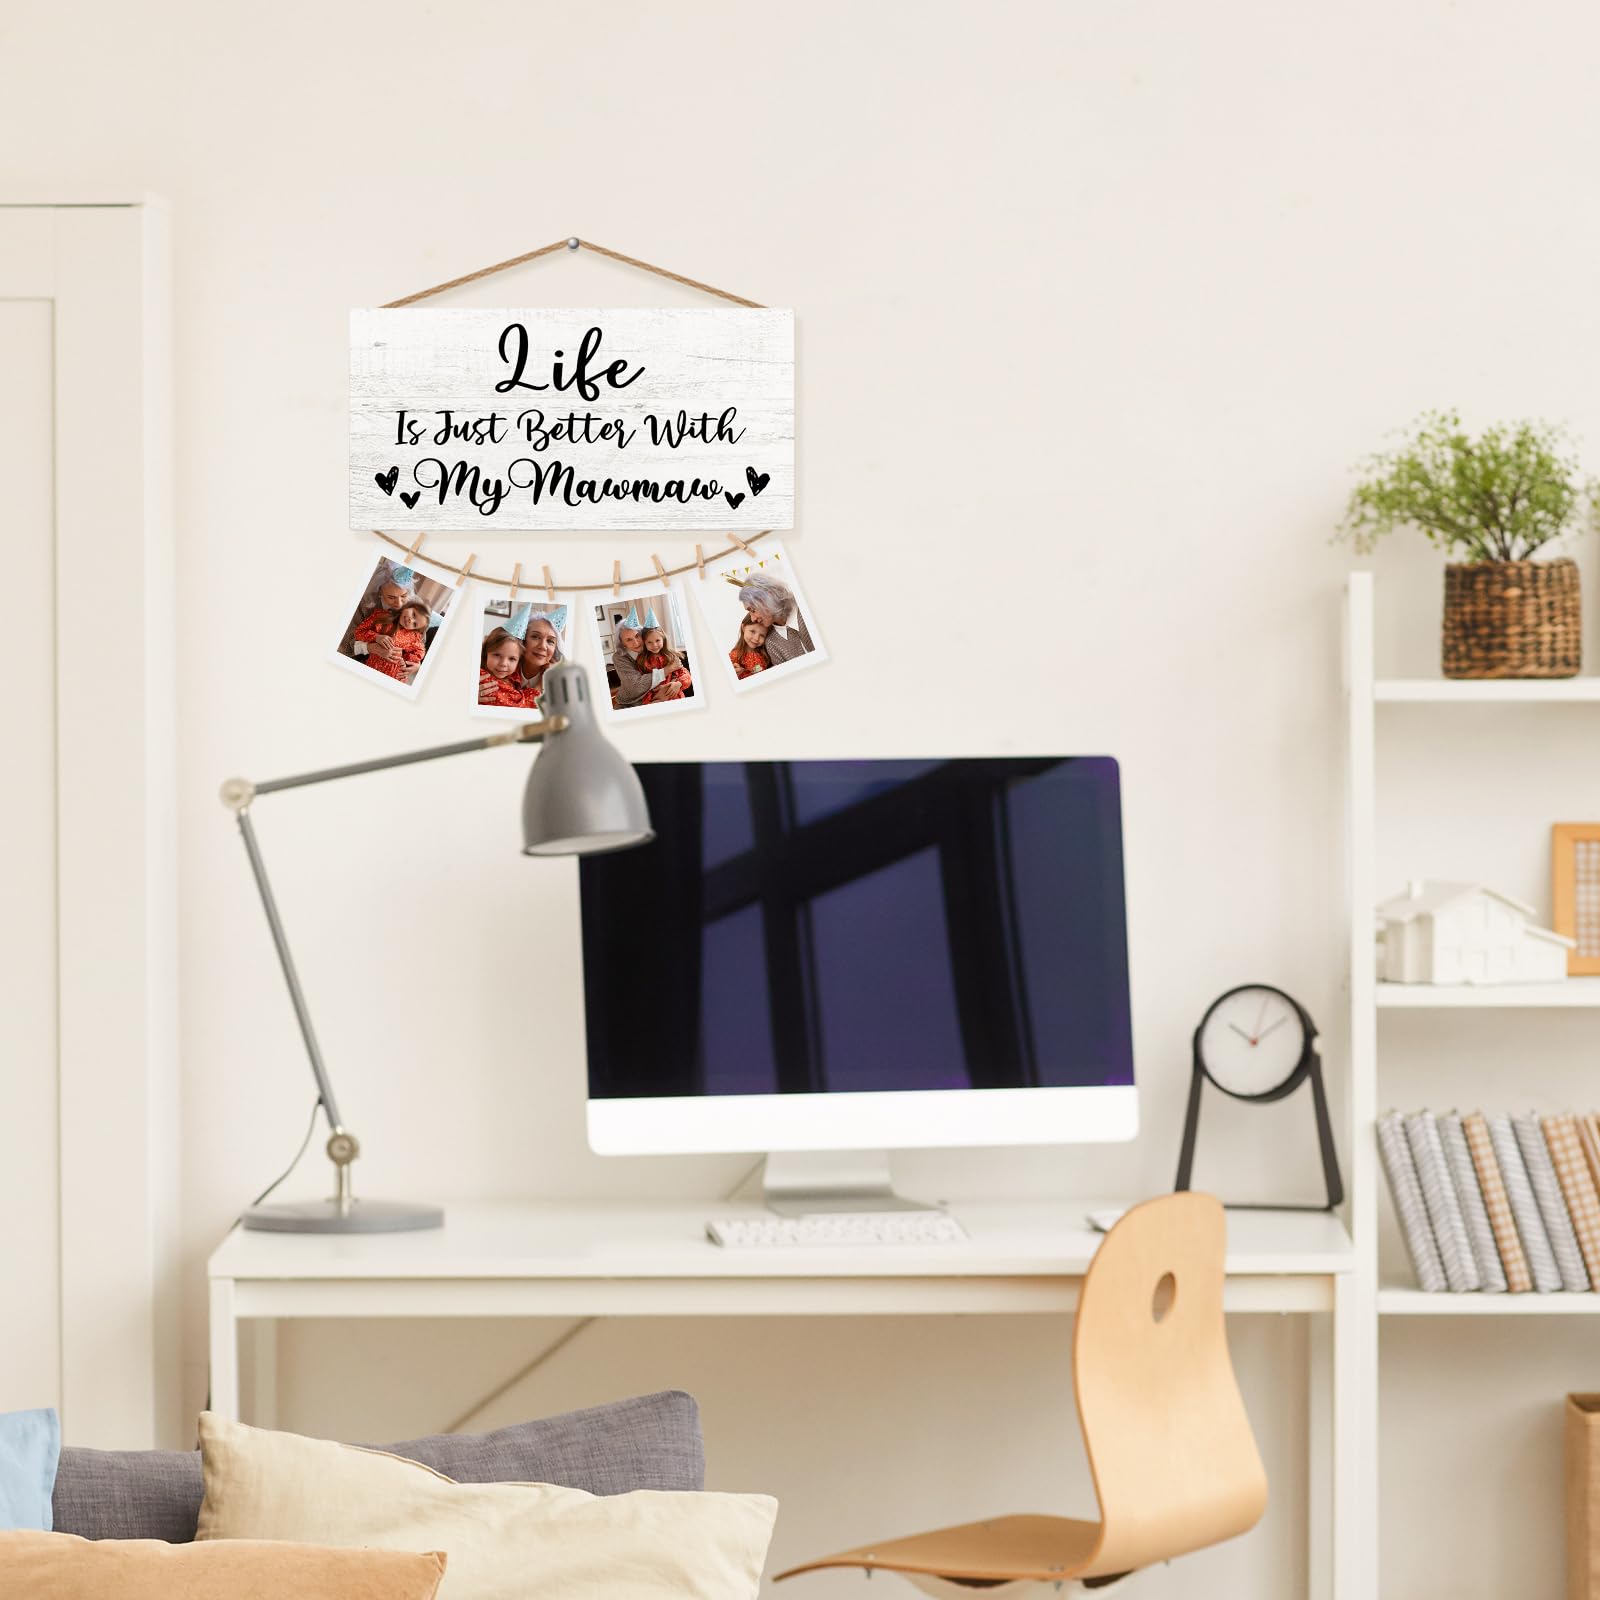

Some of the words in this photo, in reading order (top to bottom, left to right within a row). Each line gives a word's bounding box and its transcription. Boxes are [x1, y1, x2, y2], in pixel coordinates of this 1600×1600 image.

[494, 323, 646, 402] Life
[394, 410, 427, 446] Is
[433, 410, 509, 446] Just
[516, 409, 637, 452] Better
[643, 406, 747, 449] With
[413, 457, 511, 516] My
[507, 458, 724, 507] Mawmaw
